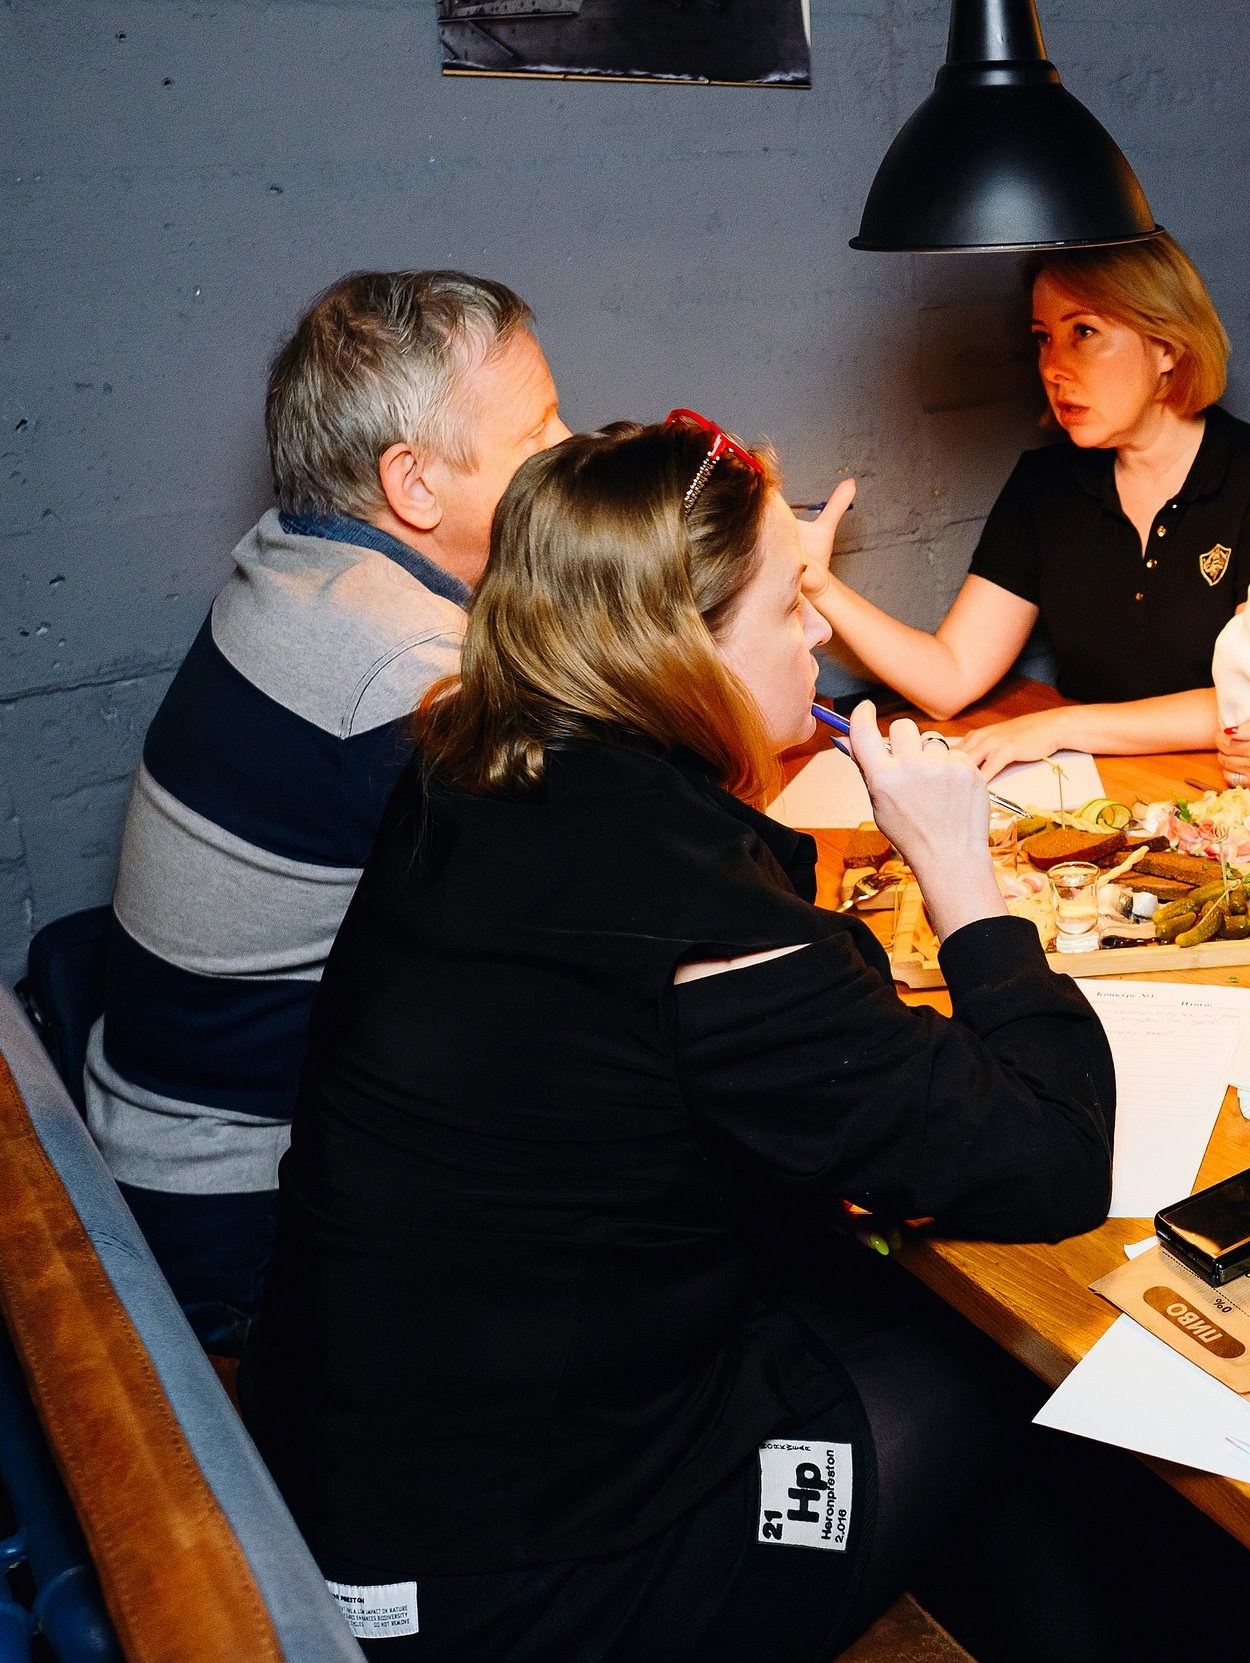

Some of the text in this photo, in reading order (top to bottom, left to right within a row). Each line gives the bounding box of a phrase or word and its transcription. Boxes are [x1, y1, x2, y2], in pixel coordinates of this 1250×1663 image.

[1166, 1302, 1224, 1343] ПИВО
[1213, 1298, 1233, 1313] 0%
[787, 1462, 828, 1523] Hp
[821, 1449, 837, 1540] Heronpreston
[762, 1509, 783, 1541] 21
